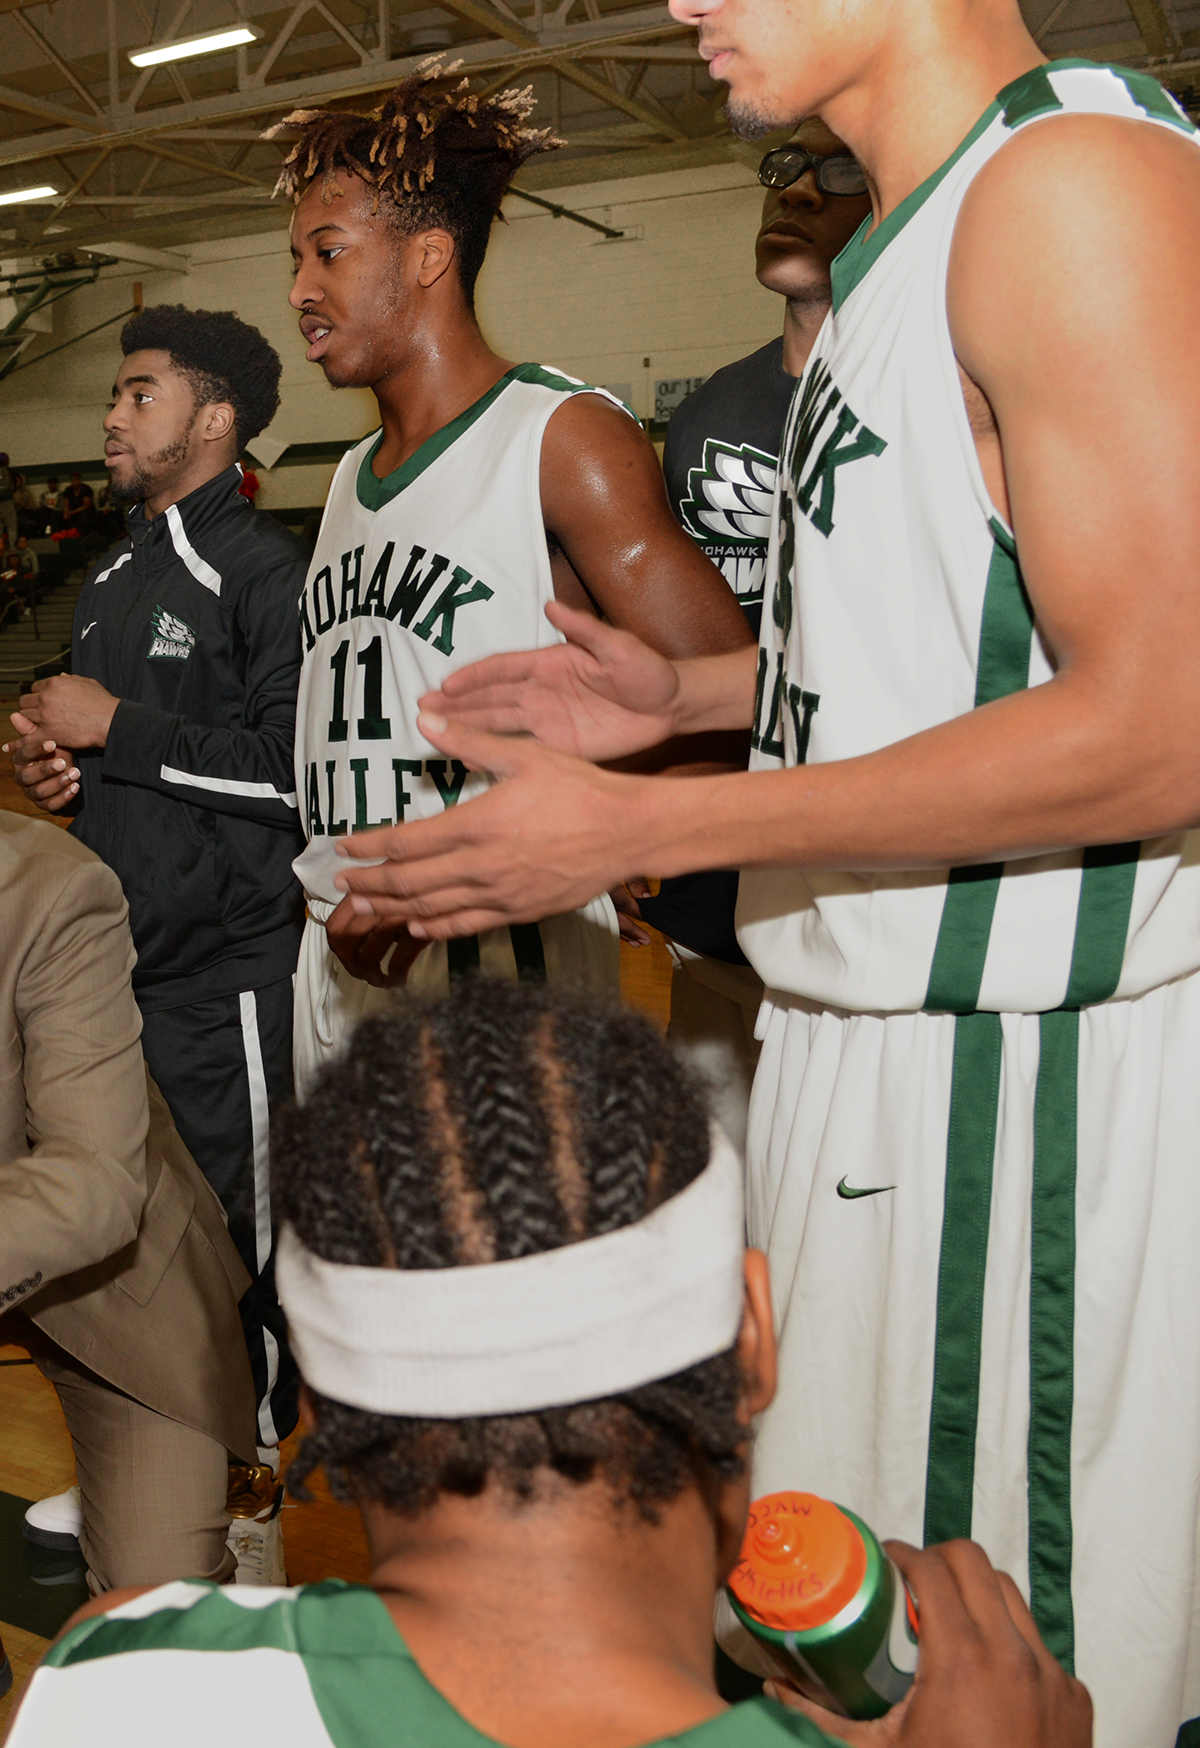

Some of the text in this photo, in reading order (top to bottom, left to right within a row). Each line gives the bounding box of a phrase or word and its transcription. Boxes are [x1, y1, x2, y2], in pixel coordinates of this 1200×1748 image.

[701, 546, 759, 557] OHAWK
[328, 636, 392, 742] 11
[305, 758, 471, 837] ALLEY
